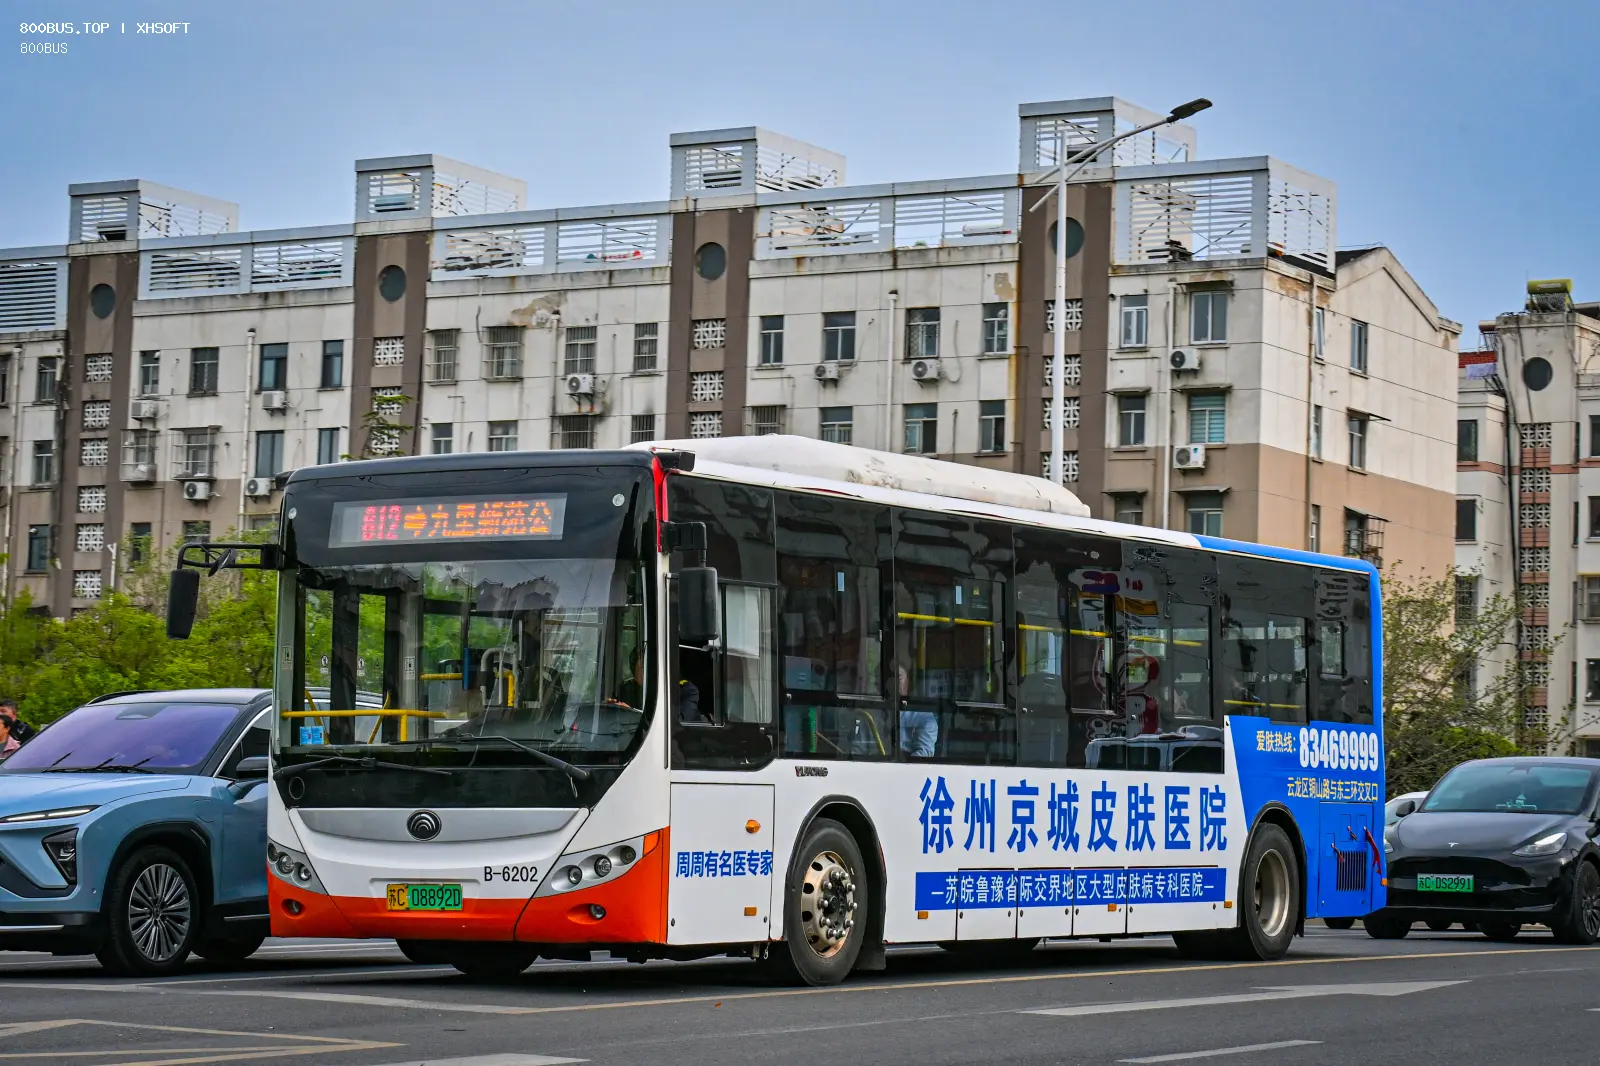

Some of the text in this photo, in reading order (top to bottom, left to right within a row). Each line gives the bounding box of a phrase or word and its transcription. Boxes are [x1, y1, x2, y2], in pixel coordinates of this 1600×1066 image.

[361, 505, 401, 541] 612
[1299, 727, 1379, 772] 83469999
[1287, 776, 1379, 802] 云龙区铜山路与东三环交叉口
[918, 775, 1227, 854] 徐州京城皮肤医院
[484, 866, 538, 882] B-6202
[676, 849, 773, 878] 周周有名医专家
